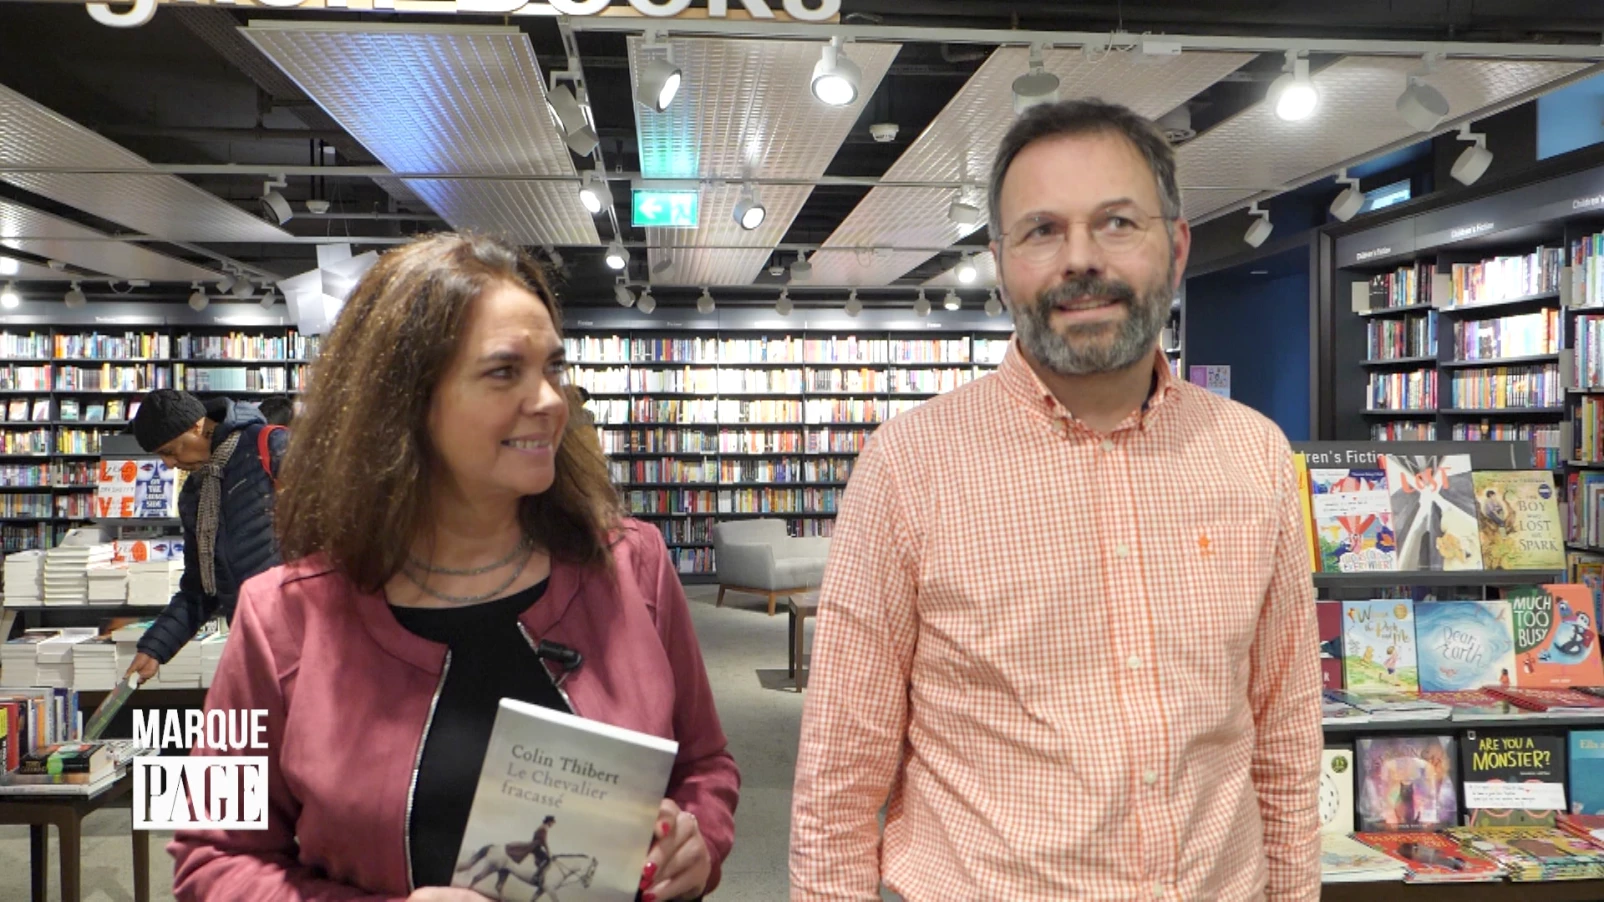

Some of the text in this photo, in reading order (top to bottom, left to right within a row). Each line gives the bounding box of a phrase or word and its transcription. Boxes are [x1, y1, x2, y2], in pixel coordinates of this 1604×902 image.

[1346, 450, 1393, 464] Ficti
[1400, 466, 1452, 494] LOST
[1518, 500, 1547, 512] BOY
[1519, 520, 1552, 532] LOST
[1519, 539, 1560, 552] SPARK
[1512, 596, 1552, 611] MUCH
[1513, 610, 1550, 628] TOO
[1443, 625, 1477, 645] Dear
[1518, 628, 1549, 648] BUSY
[1435, 641, 1488, 669] Earth
[1478, 737, 1535, 751] ARE YOU A
[510, 744, 620, 785] Colin Thibert
[1472, 749, 1552, 772] MONSTER?
[506, 761, 609, 801] Le Chevalier
[500, 778, 564, 809] fracassé
